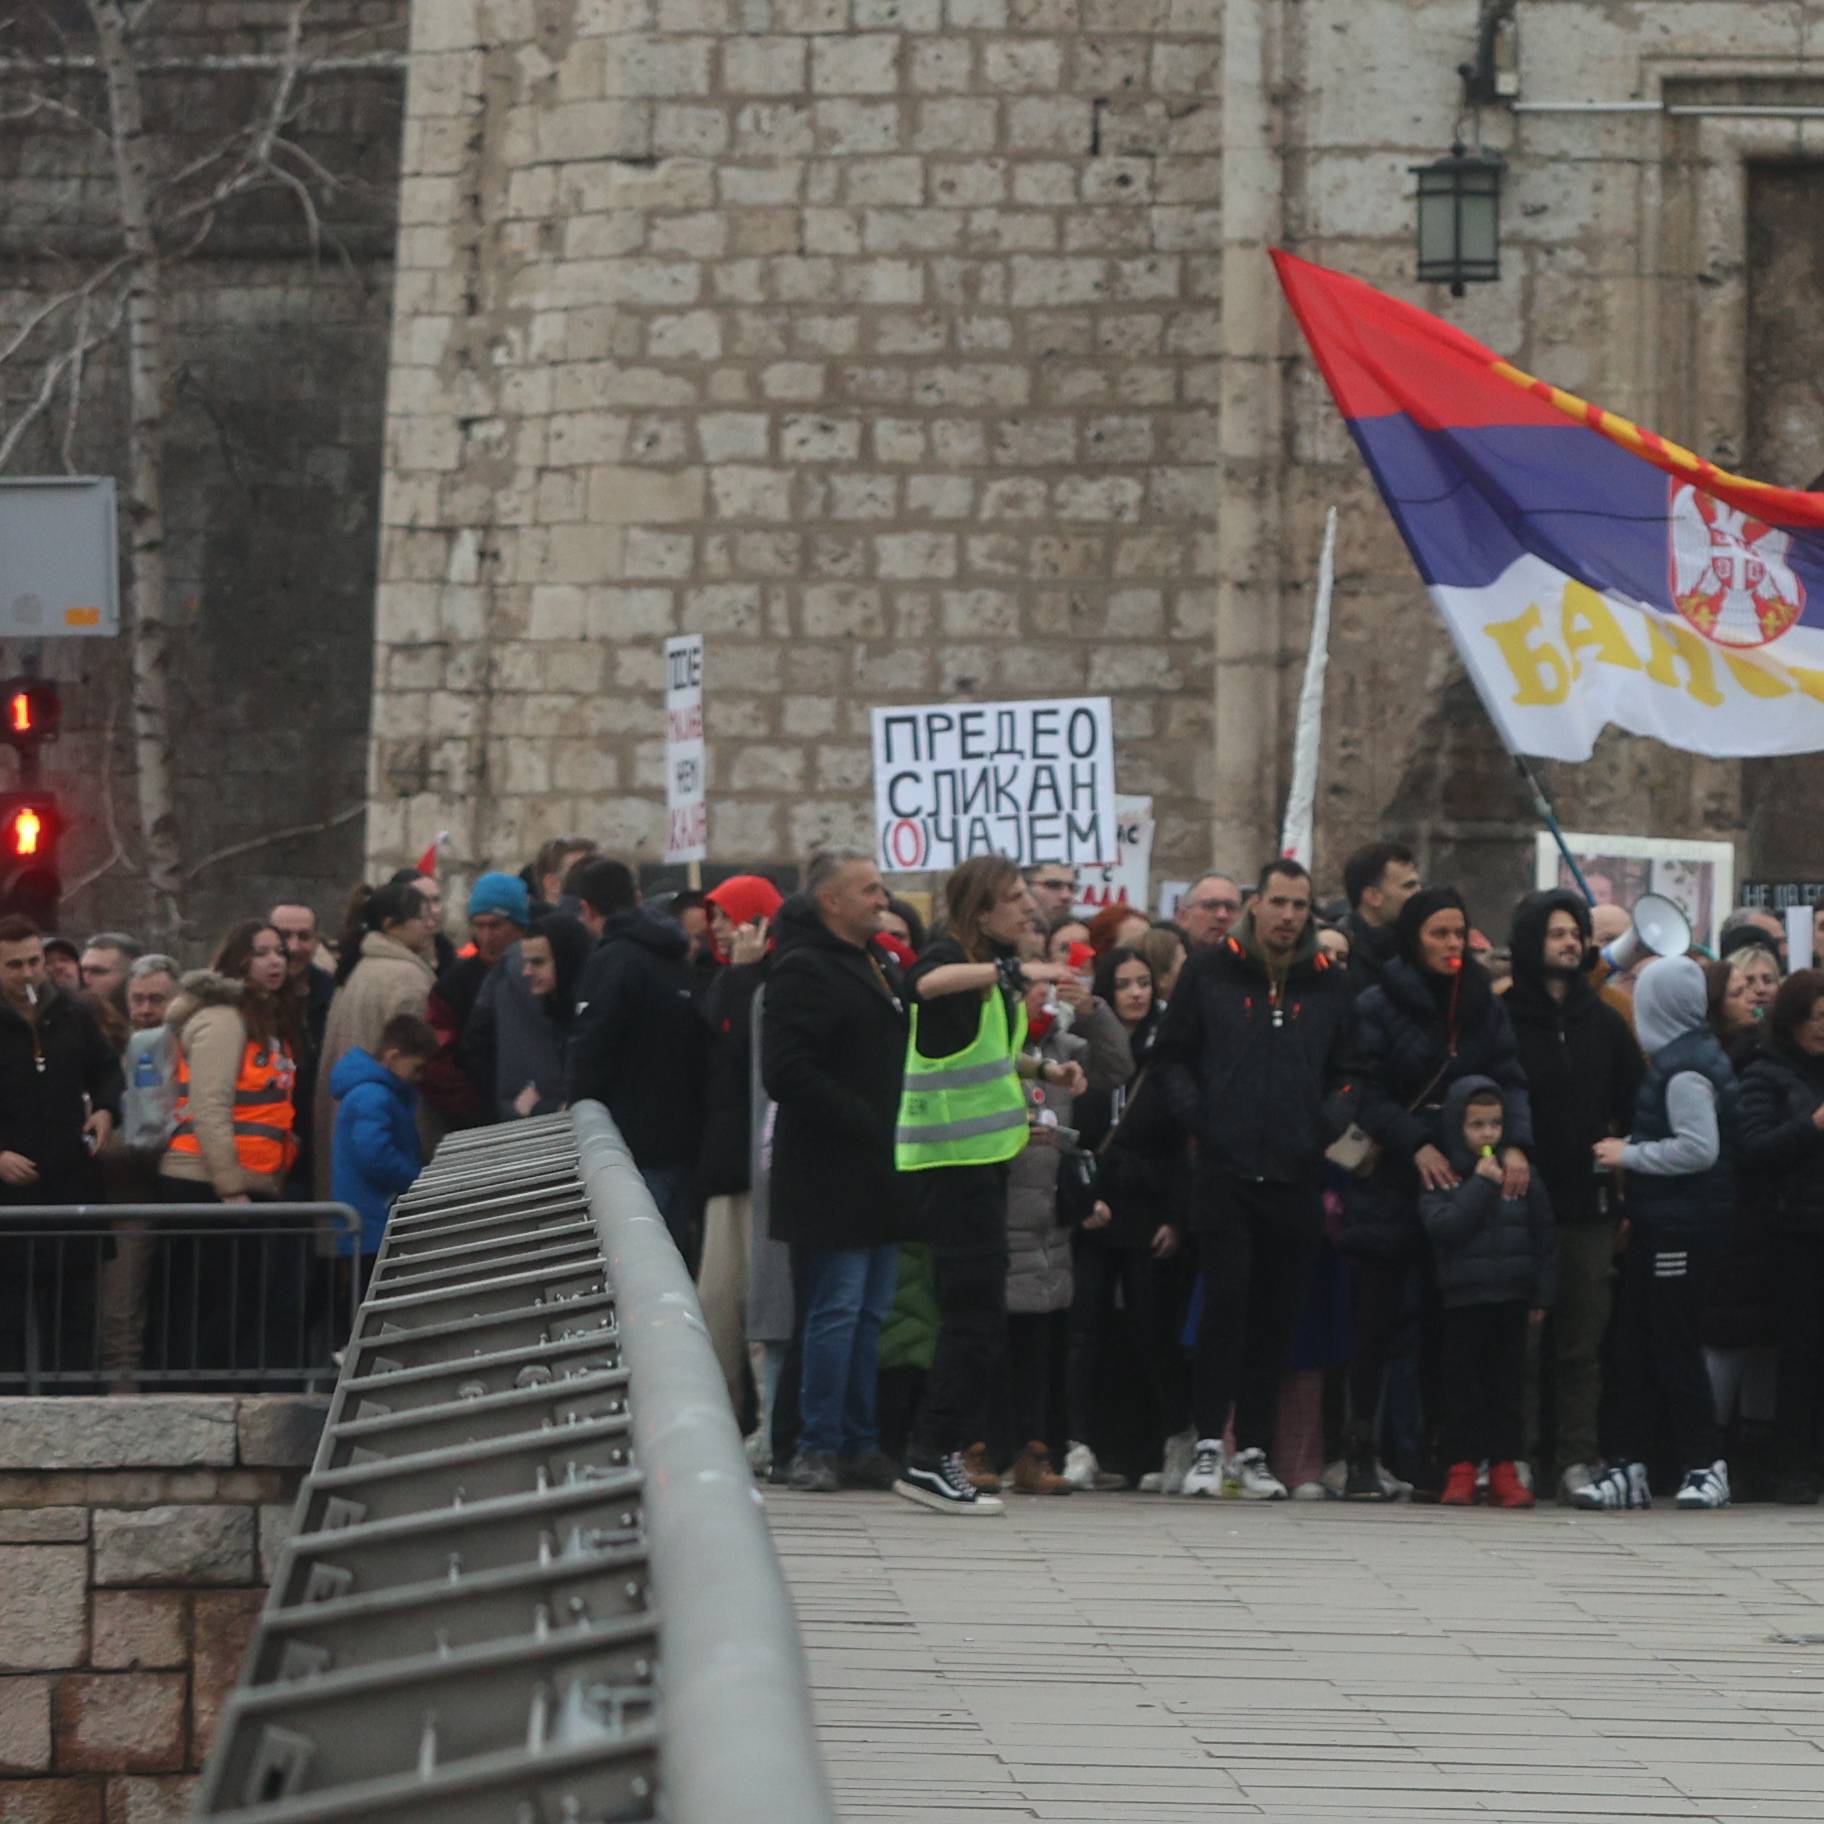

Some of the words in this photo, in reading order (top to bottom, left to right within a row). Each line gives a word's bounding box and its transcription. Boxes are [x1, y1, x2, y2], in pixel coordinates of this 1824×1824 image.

[884, 707, 1097, 763] ПРЕДЕО
[887, 761, 1098, 819] СЛИКАН
[882, 813, 1103, 869] (О)ЧАЈЕМ
